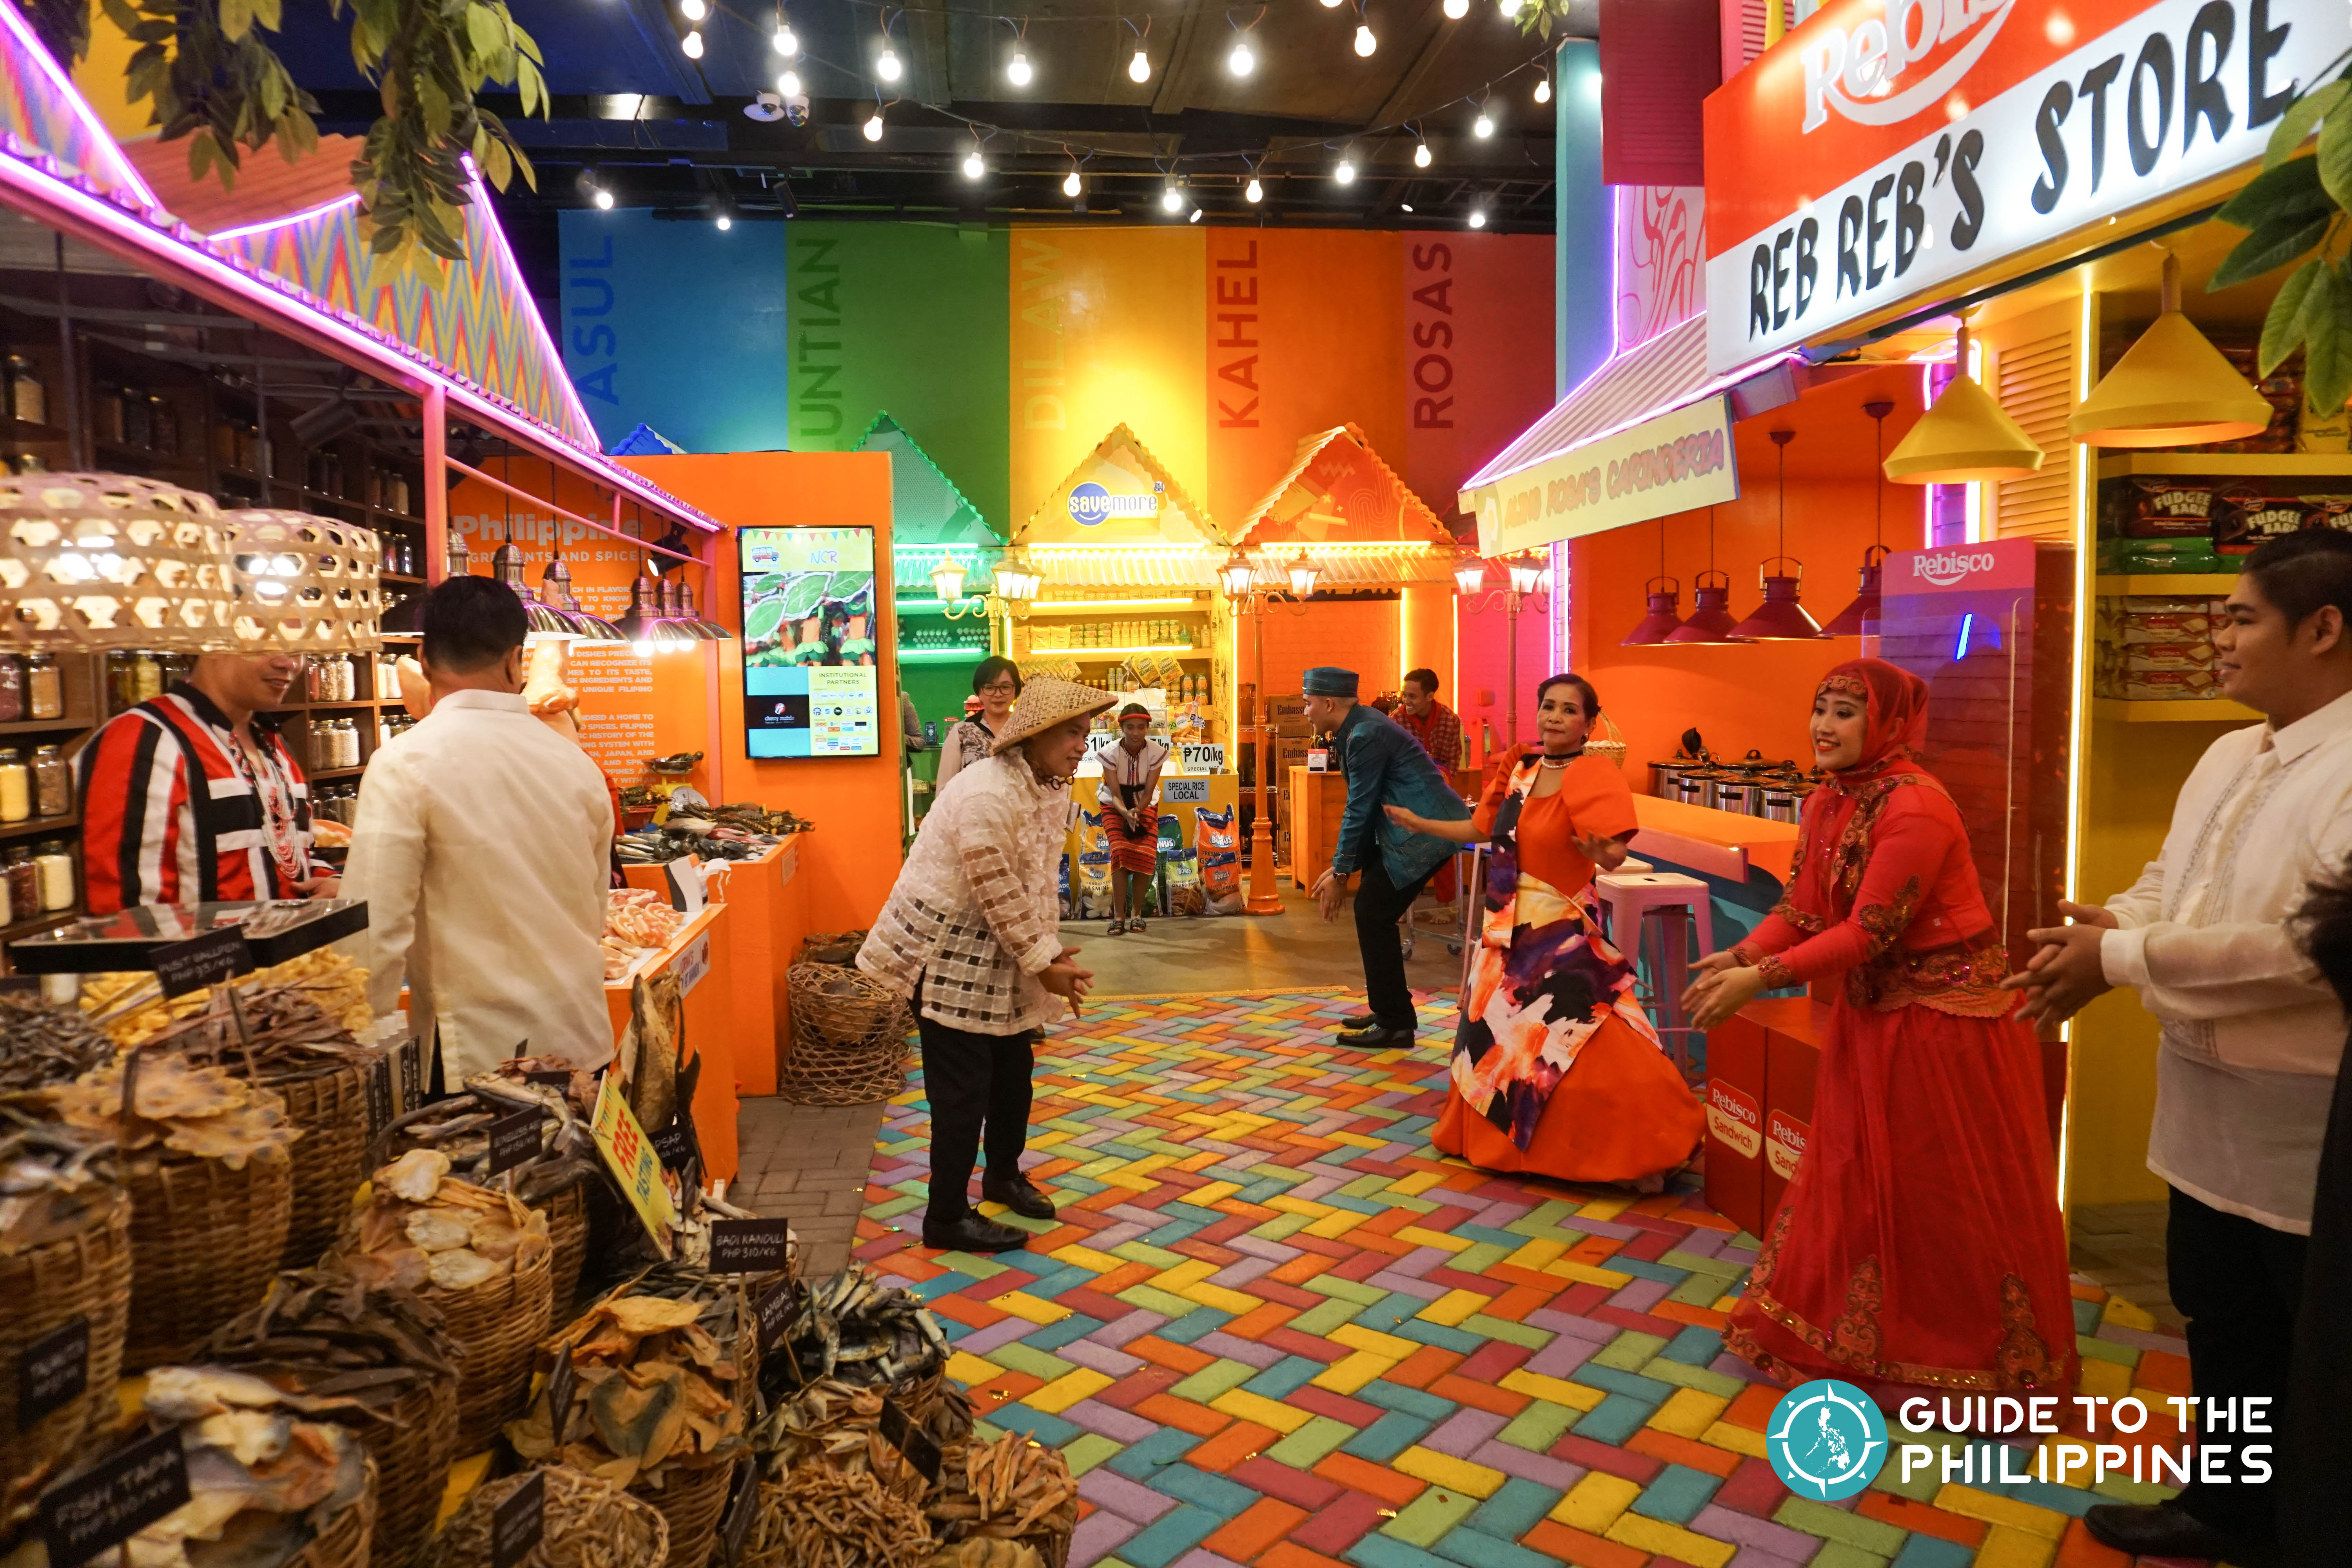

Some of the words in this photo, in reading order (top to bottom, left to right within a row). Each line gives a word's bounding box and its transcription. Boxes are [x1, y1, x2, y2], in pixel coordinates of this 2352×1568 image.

[1749, 218, 1819, 343] REB
[1837, 129, 1984, 302] REB'S
[2032, 0, 2299, 214] STORE
[569, 236, 620, 405] ASUL
[797, 238, 842, 438] UNTIAN
[1021, 238, 1065, 430] DILAW
[1216, 240, 1259, 428] KAHEL
[1412, 243, 1454, 428] ROSAS
[1546, 466, 1600, 517] ROSA'S
[1606, 428, 1724, 500] CARINDERIA
[1069, 495, 1157, 513] savemore
[2154, 491, 2212, 510] FUDGEE
[559, 551, 590, 562] AND
[595, 550, 646, 562] SPICES
[810, 550, 837, 564] NCR
[1913, 552, 1994, 577] Rebisco
[1278, 704, 1305, 715] Embass
[1283, 748, 1308, 759] Embass
[1168, 782, 1191, 791] SPECIAL
[1192, 782, 1205, 790] RICE
[1174, 791, 1199, 799] LOCAL
[1157, 839, 1174, 848] ONUS
[1211, 835, 1232, 846] BONUS
[1214, 871, 1230, 880] BONUS
[1713, 1088, 1756, 1124] Rebisco
[612, 1108, 638, 1180] FREE
[655, 1132, 681, 1148] PSAP
[1714, 1116, 1752, 1151] Sandwich
[1773, 1120, 1806, 1151] Rebis
[1775, 1150, 1797, 1175] Sand
[636, 1145, 653, 1206] TASTING
[722, 1248, 740, 1258] PHP
[742, 1247, 777, 1258] 310/KG
